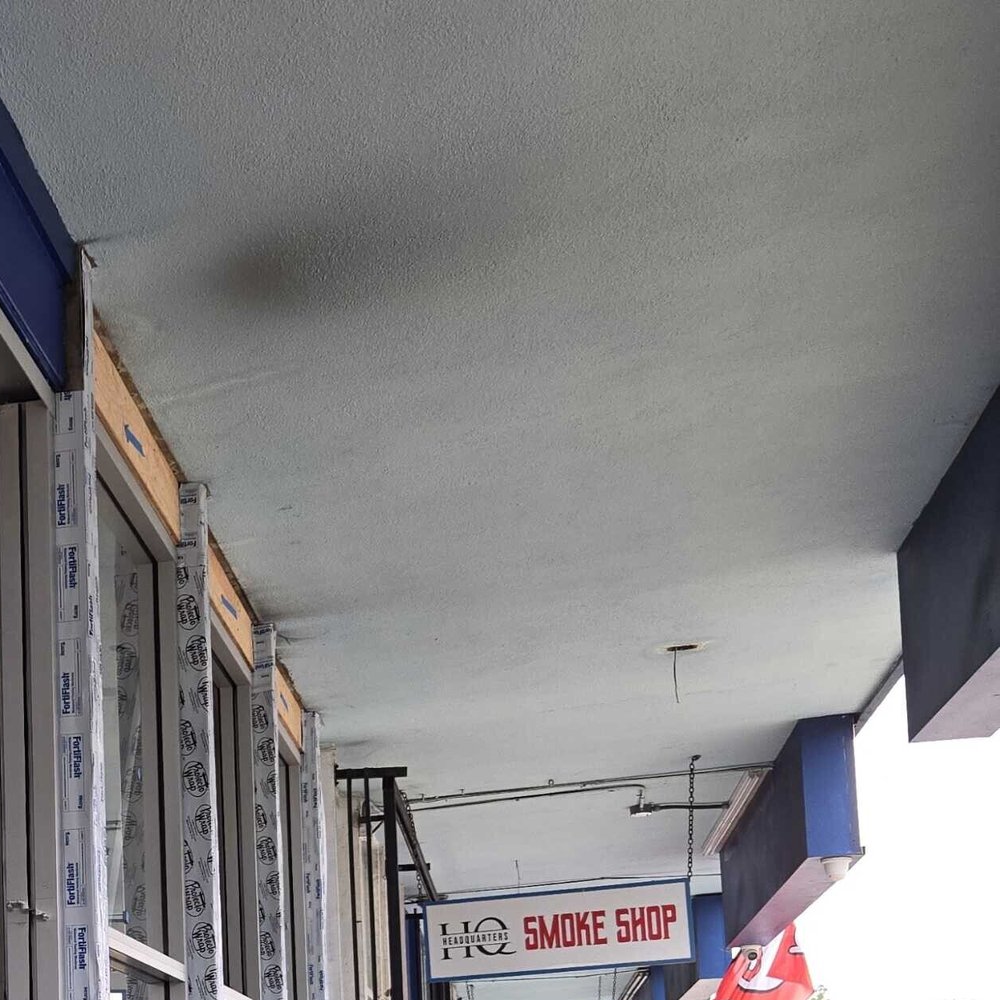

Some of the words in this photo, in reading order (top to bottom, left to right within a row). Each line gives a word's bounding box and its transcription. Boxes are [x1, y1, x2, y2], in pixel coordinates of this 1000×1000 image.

[57, 484, 66, 526] FortiFlash
[68, 546, 77, 589] FortiFlash
[62, 672, 70, 715] FortiFlash
[73, 736, 82, 779] FortiFlash
[183, 770, 196, 791] Wrap
[67, 863, 75, 905] FortiFlash
[78, 927, 87, 970] FortiFlash
[192, 932, 206, 953] Wrap
[442, 931, 509, 946] HEADQUARTERS
[523, 910, 608, 951] SMOKE
[615, 904, 677, 943] SHOP
